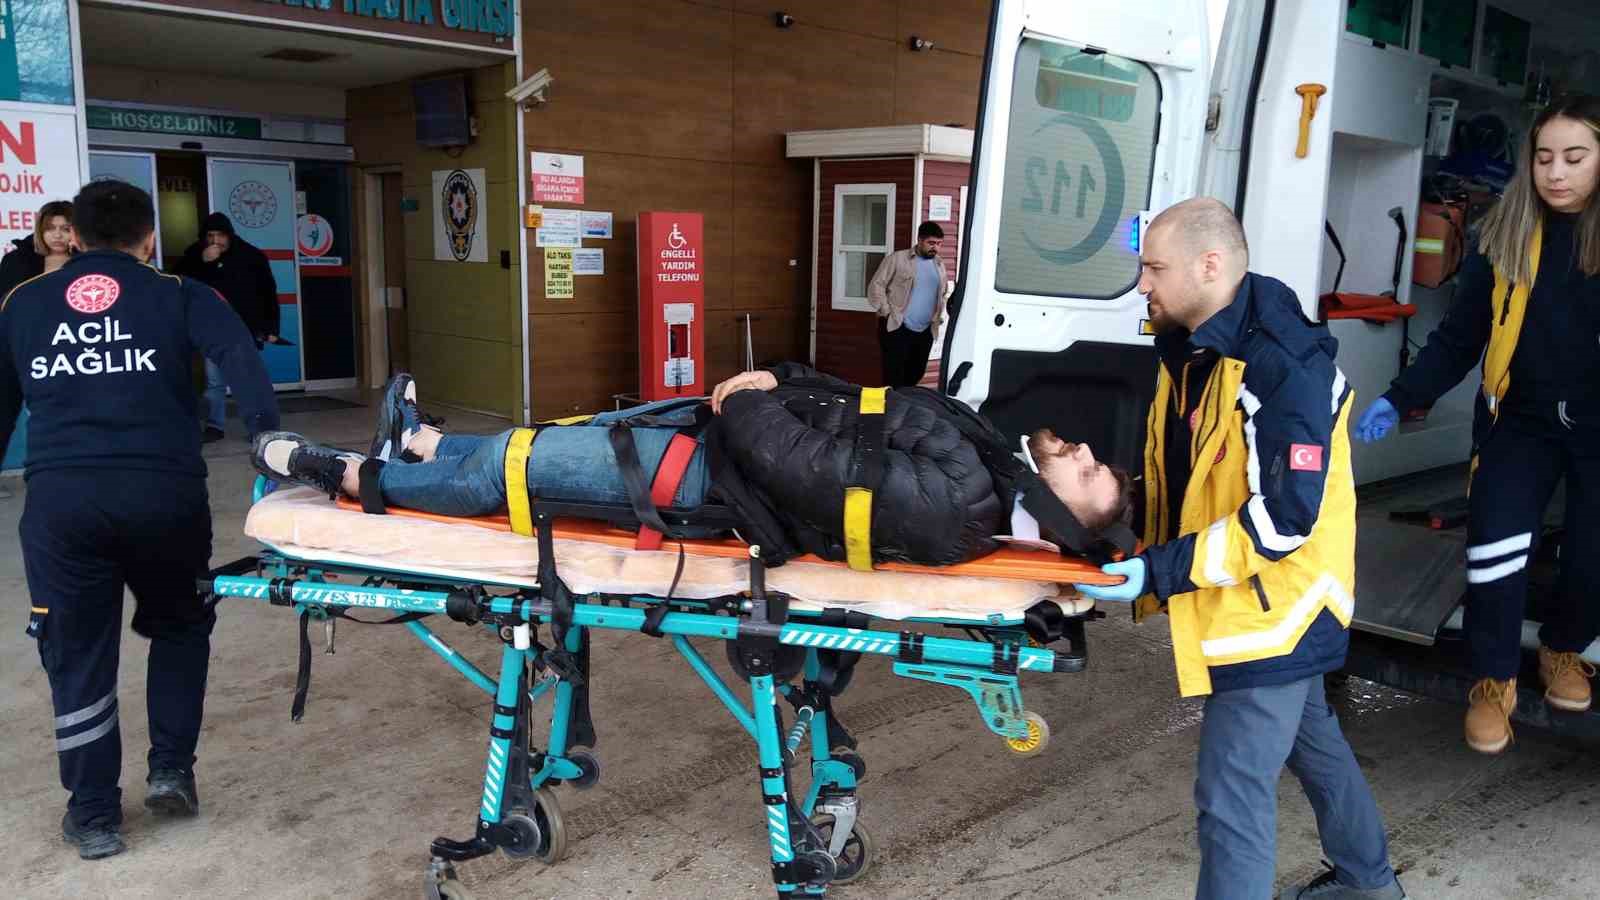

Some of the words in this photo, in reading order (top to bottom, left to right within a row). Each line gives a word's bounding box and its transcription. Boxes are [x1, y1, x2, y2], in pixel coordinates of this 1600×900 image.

[0, 210, 39, 230] LEE
[660, 248, 696, 259] ENGELLİ
[661, 261, 696, 270] YARDIM
[656, 272, 700, 282] TELEFONU
[51, 316, 133, 346] ACİL
[30, 347, 157, 380] SAĞLIK
